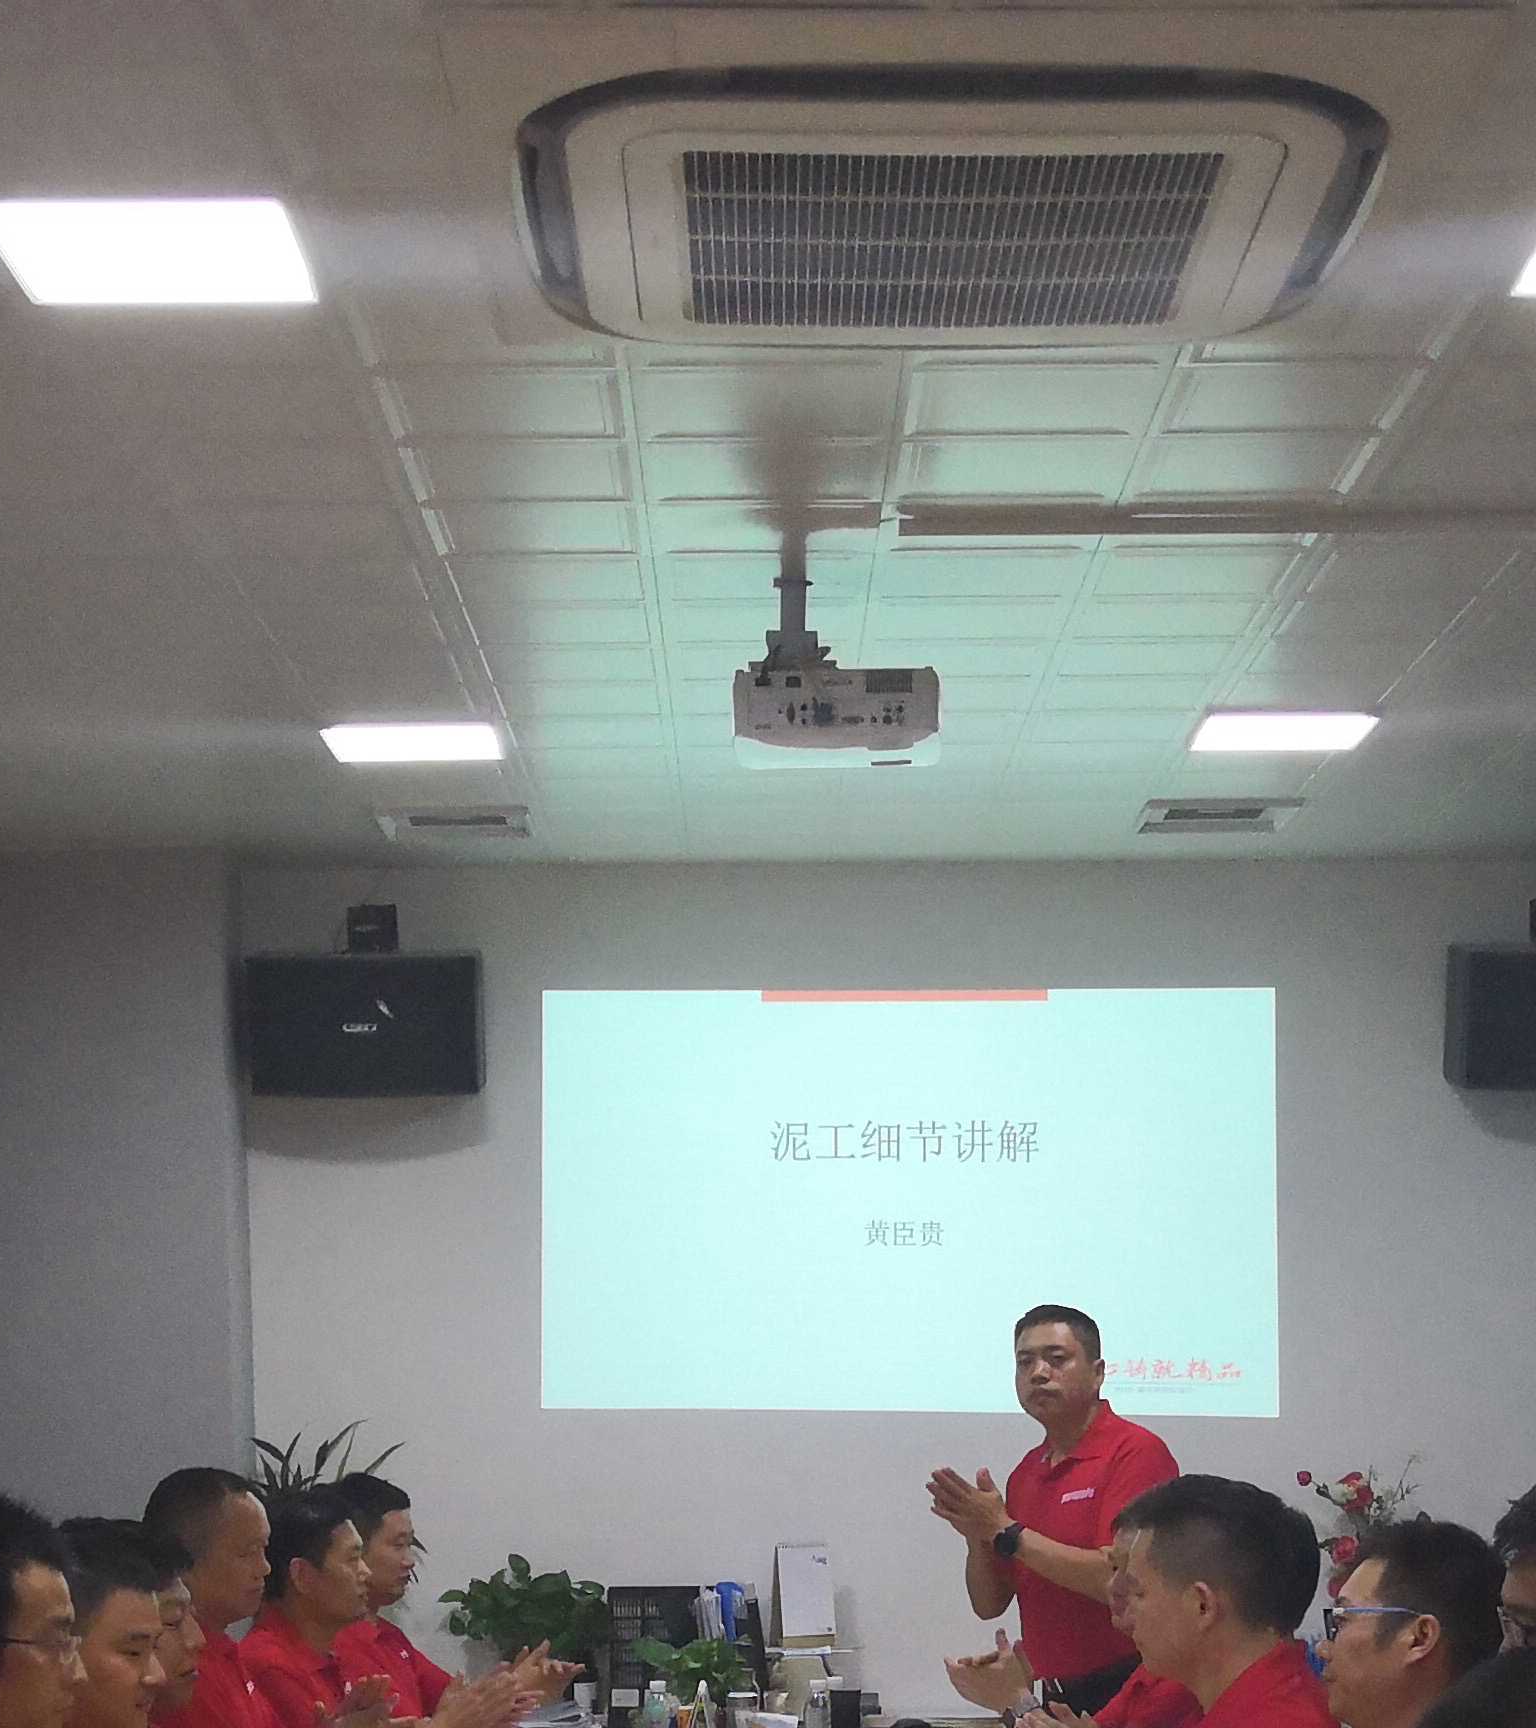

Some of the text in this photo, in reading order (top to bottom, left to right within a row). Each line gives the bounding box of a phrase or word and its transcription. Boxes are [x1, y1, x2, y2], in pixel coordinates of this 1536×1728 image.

[769, 1119, 1041, 1164] 泥工细节讲解
[863, 1219, 945, 1248] 黄臣贵
